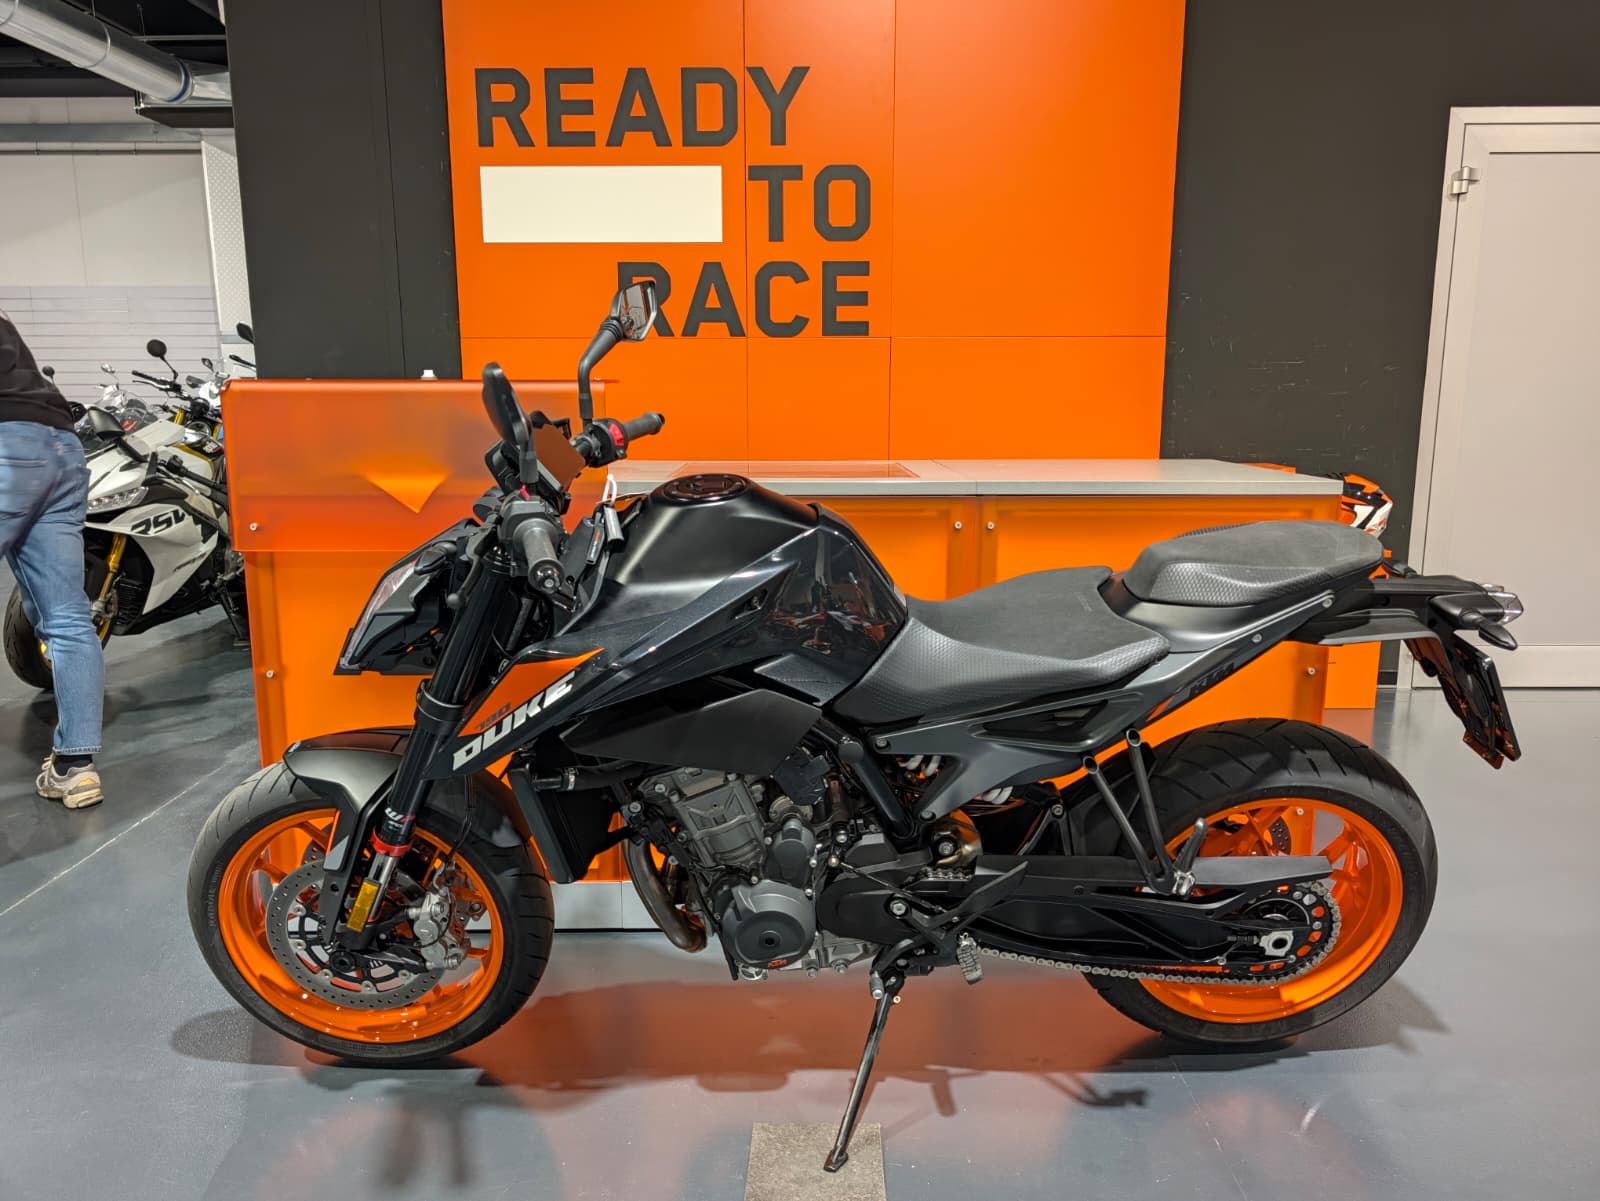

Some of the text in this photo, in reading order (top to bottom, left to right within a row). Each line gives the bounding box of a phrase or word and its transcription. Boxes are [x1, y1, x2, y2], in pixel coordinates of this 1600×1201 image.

[475, 66, 810, 147] READY
[748, 164, 871, 242] TO
[617, 261, 870, 337] RACE
[453, 670, 576, 771] DUKE
